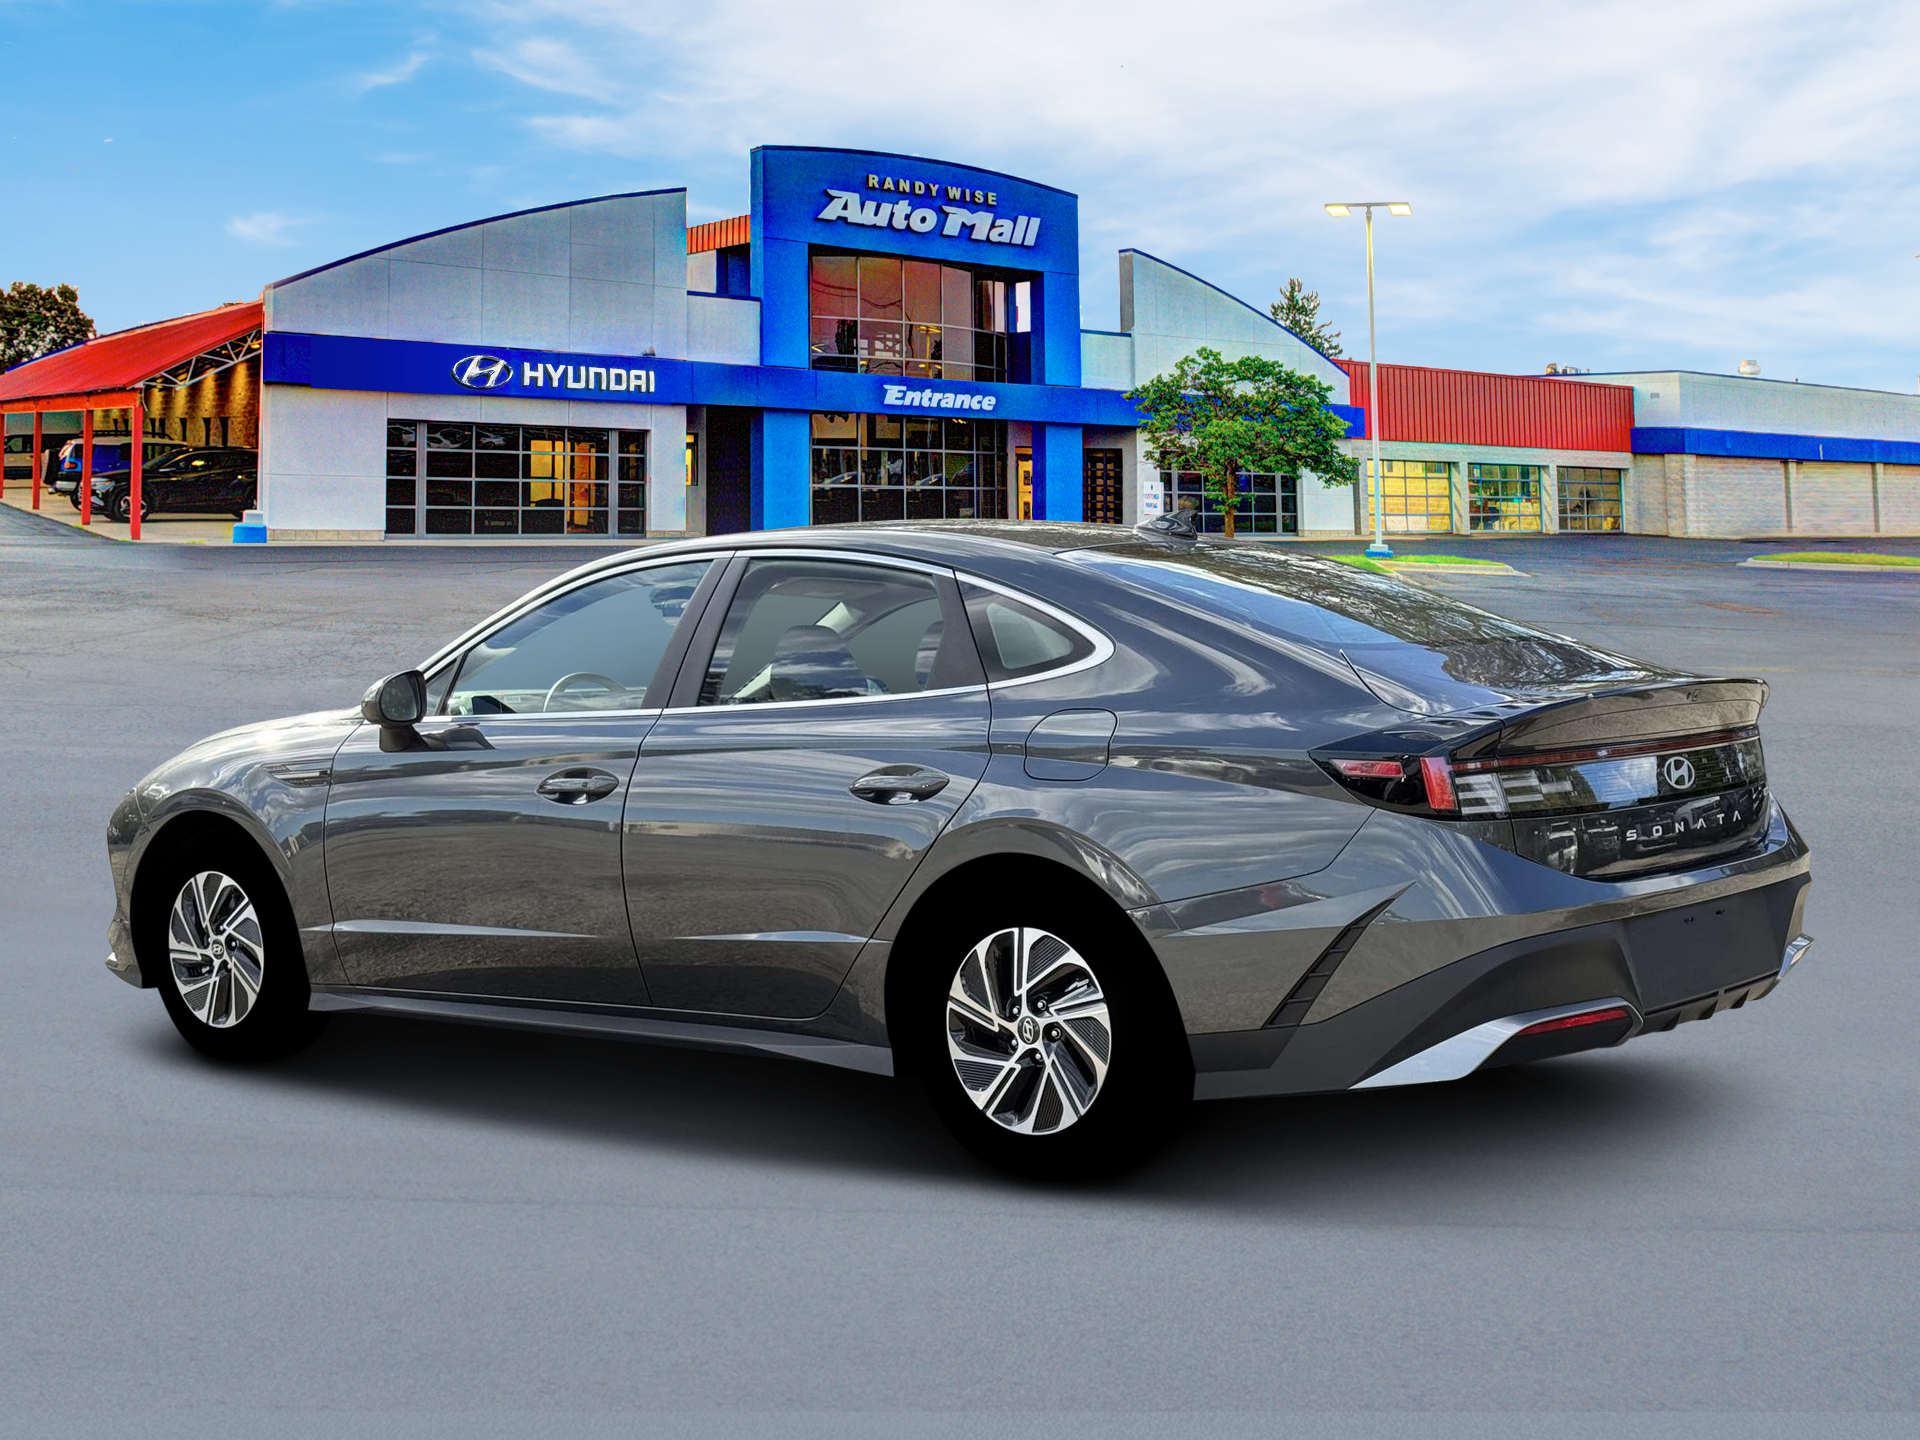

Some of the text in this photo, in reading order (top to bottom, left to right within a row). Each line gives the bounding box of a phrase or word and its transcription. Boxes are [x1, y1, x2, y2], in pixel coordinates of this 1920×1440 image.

[866, 173, 998, 206] RANDY WISE
[815, 188, 1041, 247] Auto Mall
[522, 361, 656, 393] HYUNDAI
[883, 383, 997, 411] Entrance
[1625, 809, 1742, 841] SONATA
